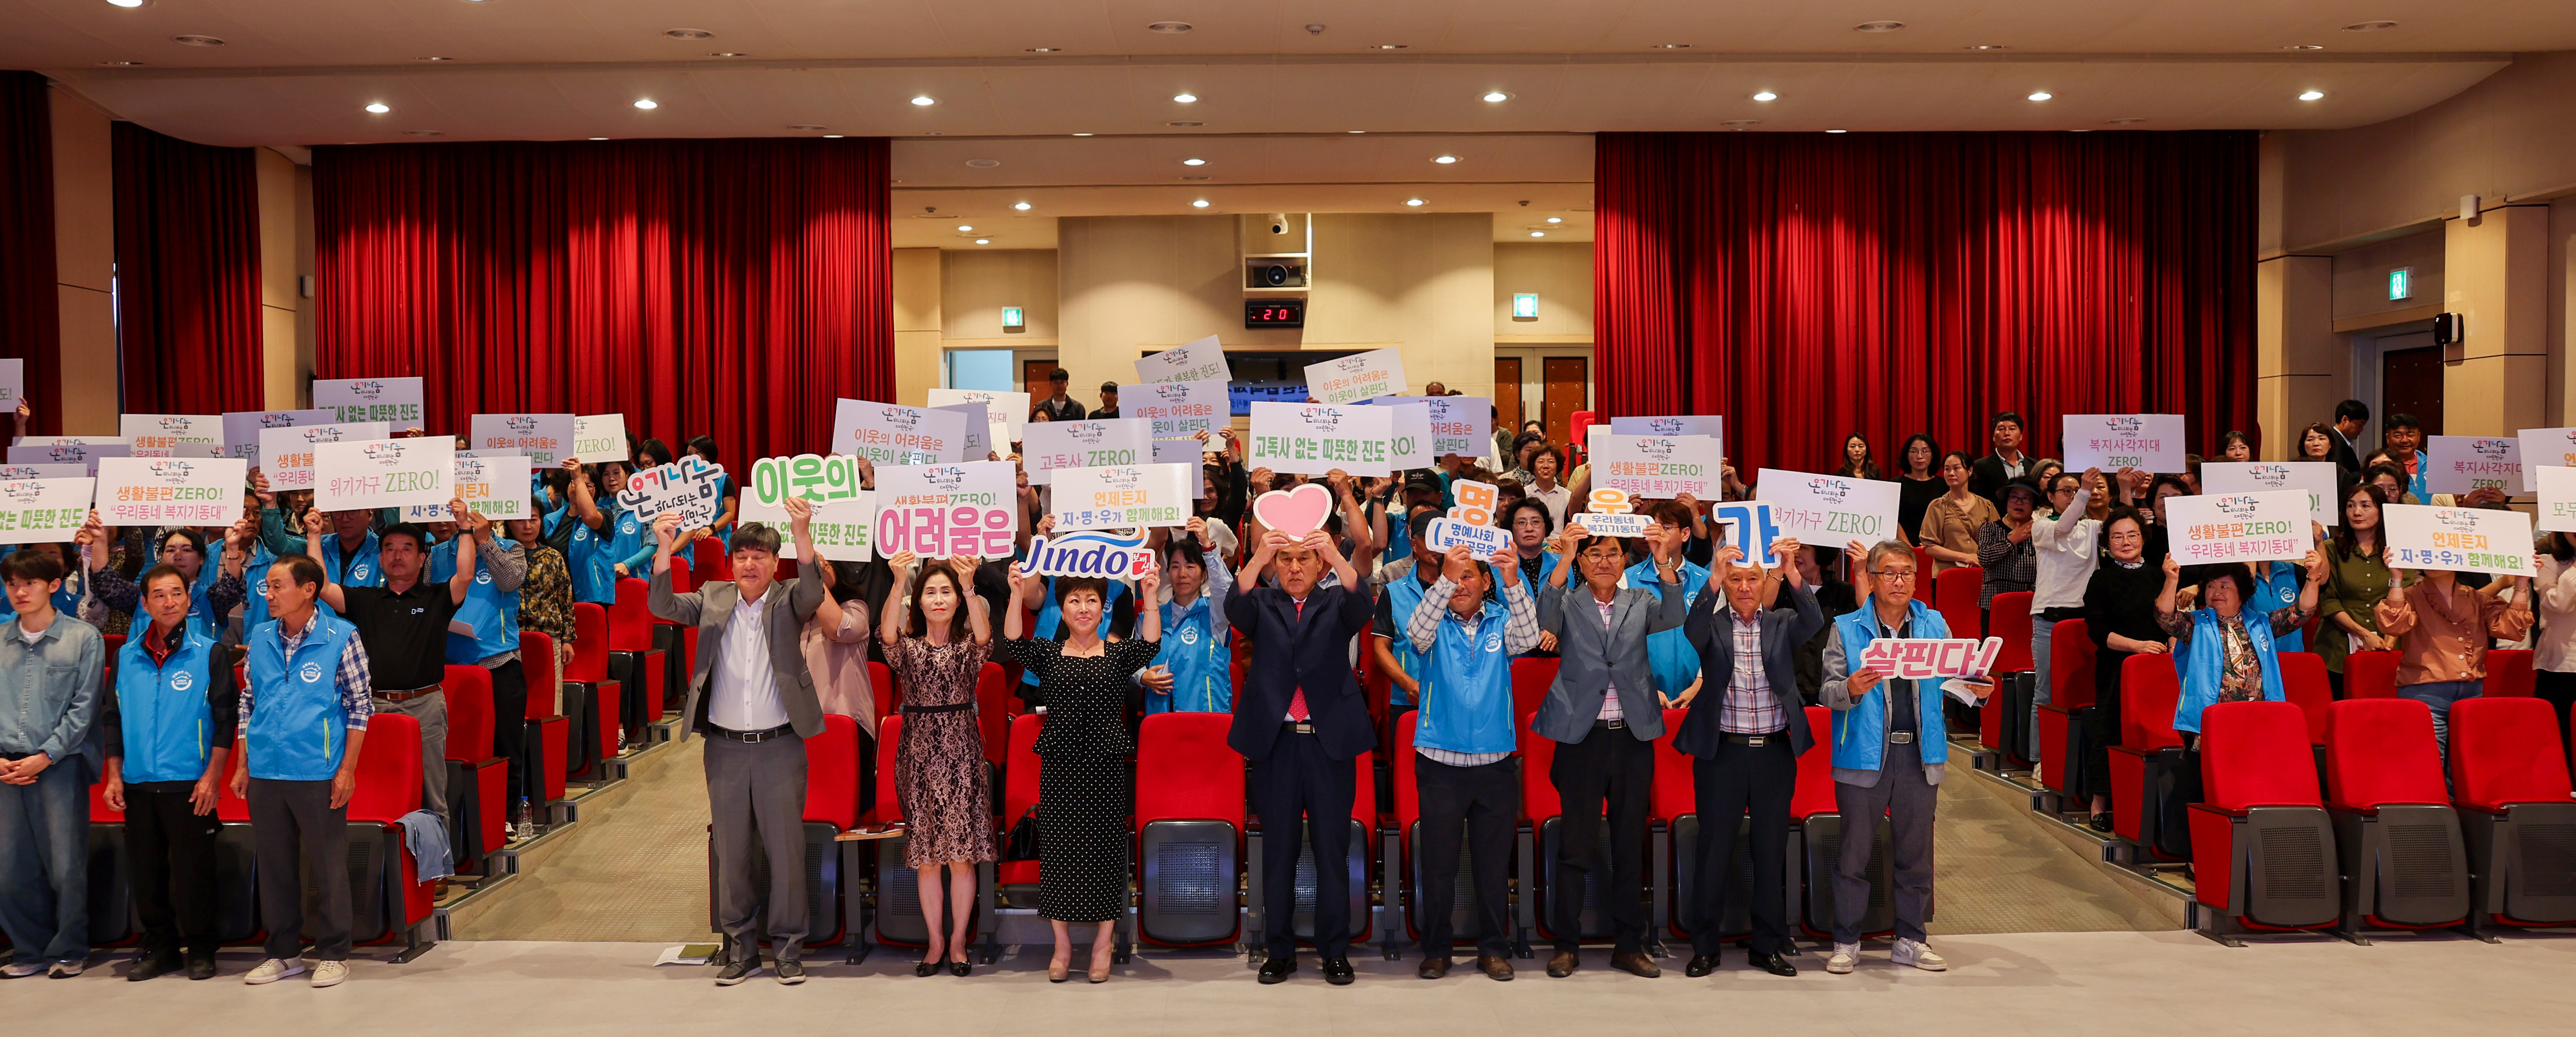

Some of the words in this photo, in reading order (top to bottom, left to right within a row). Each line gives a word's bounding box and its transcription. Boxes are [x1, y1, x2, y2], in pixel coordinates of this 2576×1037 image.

[1163, 349, 1189, 364] 온기나눔
[1338, 357, 1366, 370] 온기나눔
[1200, 362, 1221, 378] 진도!
[351, 381, 383, 394] 온기나눔
[1323, 379, 1349, 391] 이웃의
[1352, 370, 1388, 385] 어려움은
[0, 388, 12, 400] 도!
[1157, 385, 1189, 397] 온기나눔
[1329, 388, 1357, 403] 이웃이
[1360, 381, 1388, 396] 살핀다
[370, 404, 397, 421] 따뜻한
[400, 404, 419, 421] 진도
[882, 407, 921, 425] 온기나눔
[1137, 407, 1167, 419] 이웃의
[1171, 404, 1212, 417] 어려움은
[1300, 407, 1343, 424] 온기나눔
[159, 418, 191, 429] 온기나눔
[261, 414, 294, 428] 온기나눔
[507, 417, 538, 429] 온기나눔
[1152, 420, 1174, 434] 웃이
[1178, 418, 1210, 432] 살핀다
[1650, 419, 1683, 431] 온기나눔
[2106, 417, 2142, 431] 온기나눔
[304, 428, 343, 443] 온기나눔
[1067, 423, 1106, 437] 온기나눔
[487, 437, 515, 449] 이웃의
[519, 437, 557, 449] 어려움은
[575, 437, 615, 454] ZERO!
[854, 428, 890, 445] 이웃의
[895, 433, 943, 451] 어려움은
[964, 434, 981, 449] 도!
[1391, 436, 1416, 455] RO!
[1435, 438, 1469, 452] 살핀다
[1637, 439, 1675, 453] 온기나눔
[2090, 439, 2160, 452] 복지사각지대
[2473, 440, 2510, 453] 온기나눔
[50, 448, 86, 461] 온기나눔
[364, 443, 405, 459] 온기나눔
[1255, 436, 1290, 458] 고독사
[1295, 437, 1318, 460] 없는
[1323, 438, 1358, 461] 따뜻한
[1361, 440, 1385, 462] 진도
[1040, 453, 1082, 470] 고독사
[1088, 449, 1136, 467] ZERO!
[2108, 456, 2142, 467] ZERO!
[151, 461, 194, 476] 온기나눔
[455, 461, 484, 475] 기나눔
[923, 467, 966, 483] 온기나눔
[1100, 468, 1142, 483] 온기나눔
[1609, 461, 1703, 476] 생활불편ZERO!
[2249, 465, 2290, 479] 온기나눔
[330, 476, 381, 497] 위기가구
[385, 469, 439, 492] ZERO!
[621, 459, 719, 518] 온기나눔
[756, 458, 857, 504] 이웃의
[1808, 478, 1851, 497] 온기나눔
[2472, 479, 2507, 490] ZERO!
[5, 482, 46, 497] 온기나눔
[116, 486, 223, 501] 생활불편ZERO!
[455, 483, 489, 498] 제든지
[655, 492, 698, 512] 하나되는
[1094, 490, 1147, 507] 언제든지
[1459, 484, 1494, 526] 명
[1592, 490, 1628, 514] 우
[2216, 496, 2260, 512] 온기나눔
[21, 508, 56, 530] 따뜻한
[60, 508, 84, 528] 진도
[111, 505, 161, 520] “우리동네
[165, 505, 227, 520] 복지기동대”
[679, 505, 711, 528] 한민국
[1126, 507, 1180, 522] 함께해요!
[1592, 515, 1634, 524] 우리동네
[2436, 510, 2479, 526] 온기나눔
[880, 506, 1011, 555] 어려움은
[1587, 525, 1641, 534] 복지기동대
[1826, 511, 1882, 536] ZERO!
[2188, 520, 2293, 540] 생활불편ZERO!
[844, 524, 868, 546] 진도
[1451, 524, 1494, 542] 명예사회
[1718, 505, 1780, 564] 가
[2432, 532, 2488, 550] 언제든지
[1020, 539, 1129, 574] Jindo
[2185, 541, 2236, 559] “우리동네
[2239, 538, 2299, 557] 복지기동대”
[2467, 552, 2524, 570] 함께해요!
[1865, 641, 1998, 676] 살핀다!
